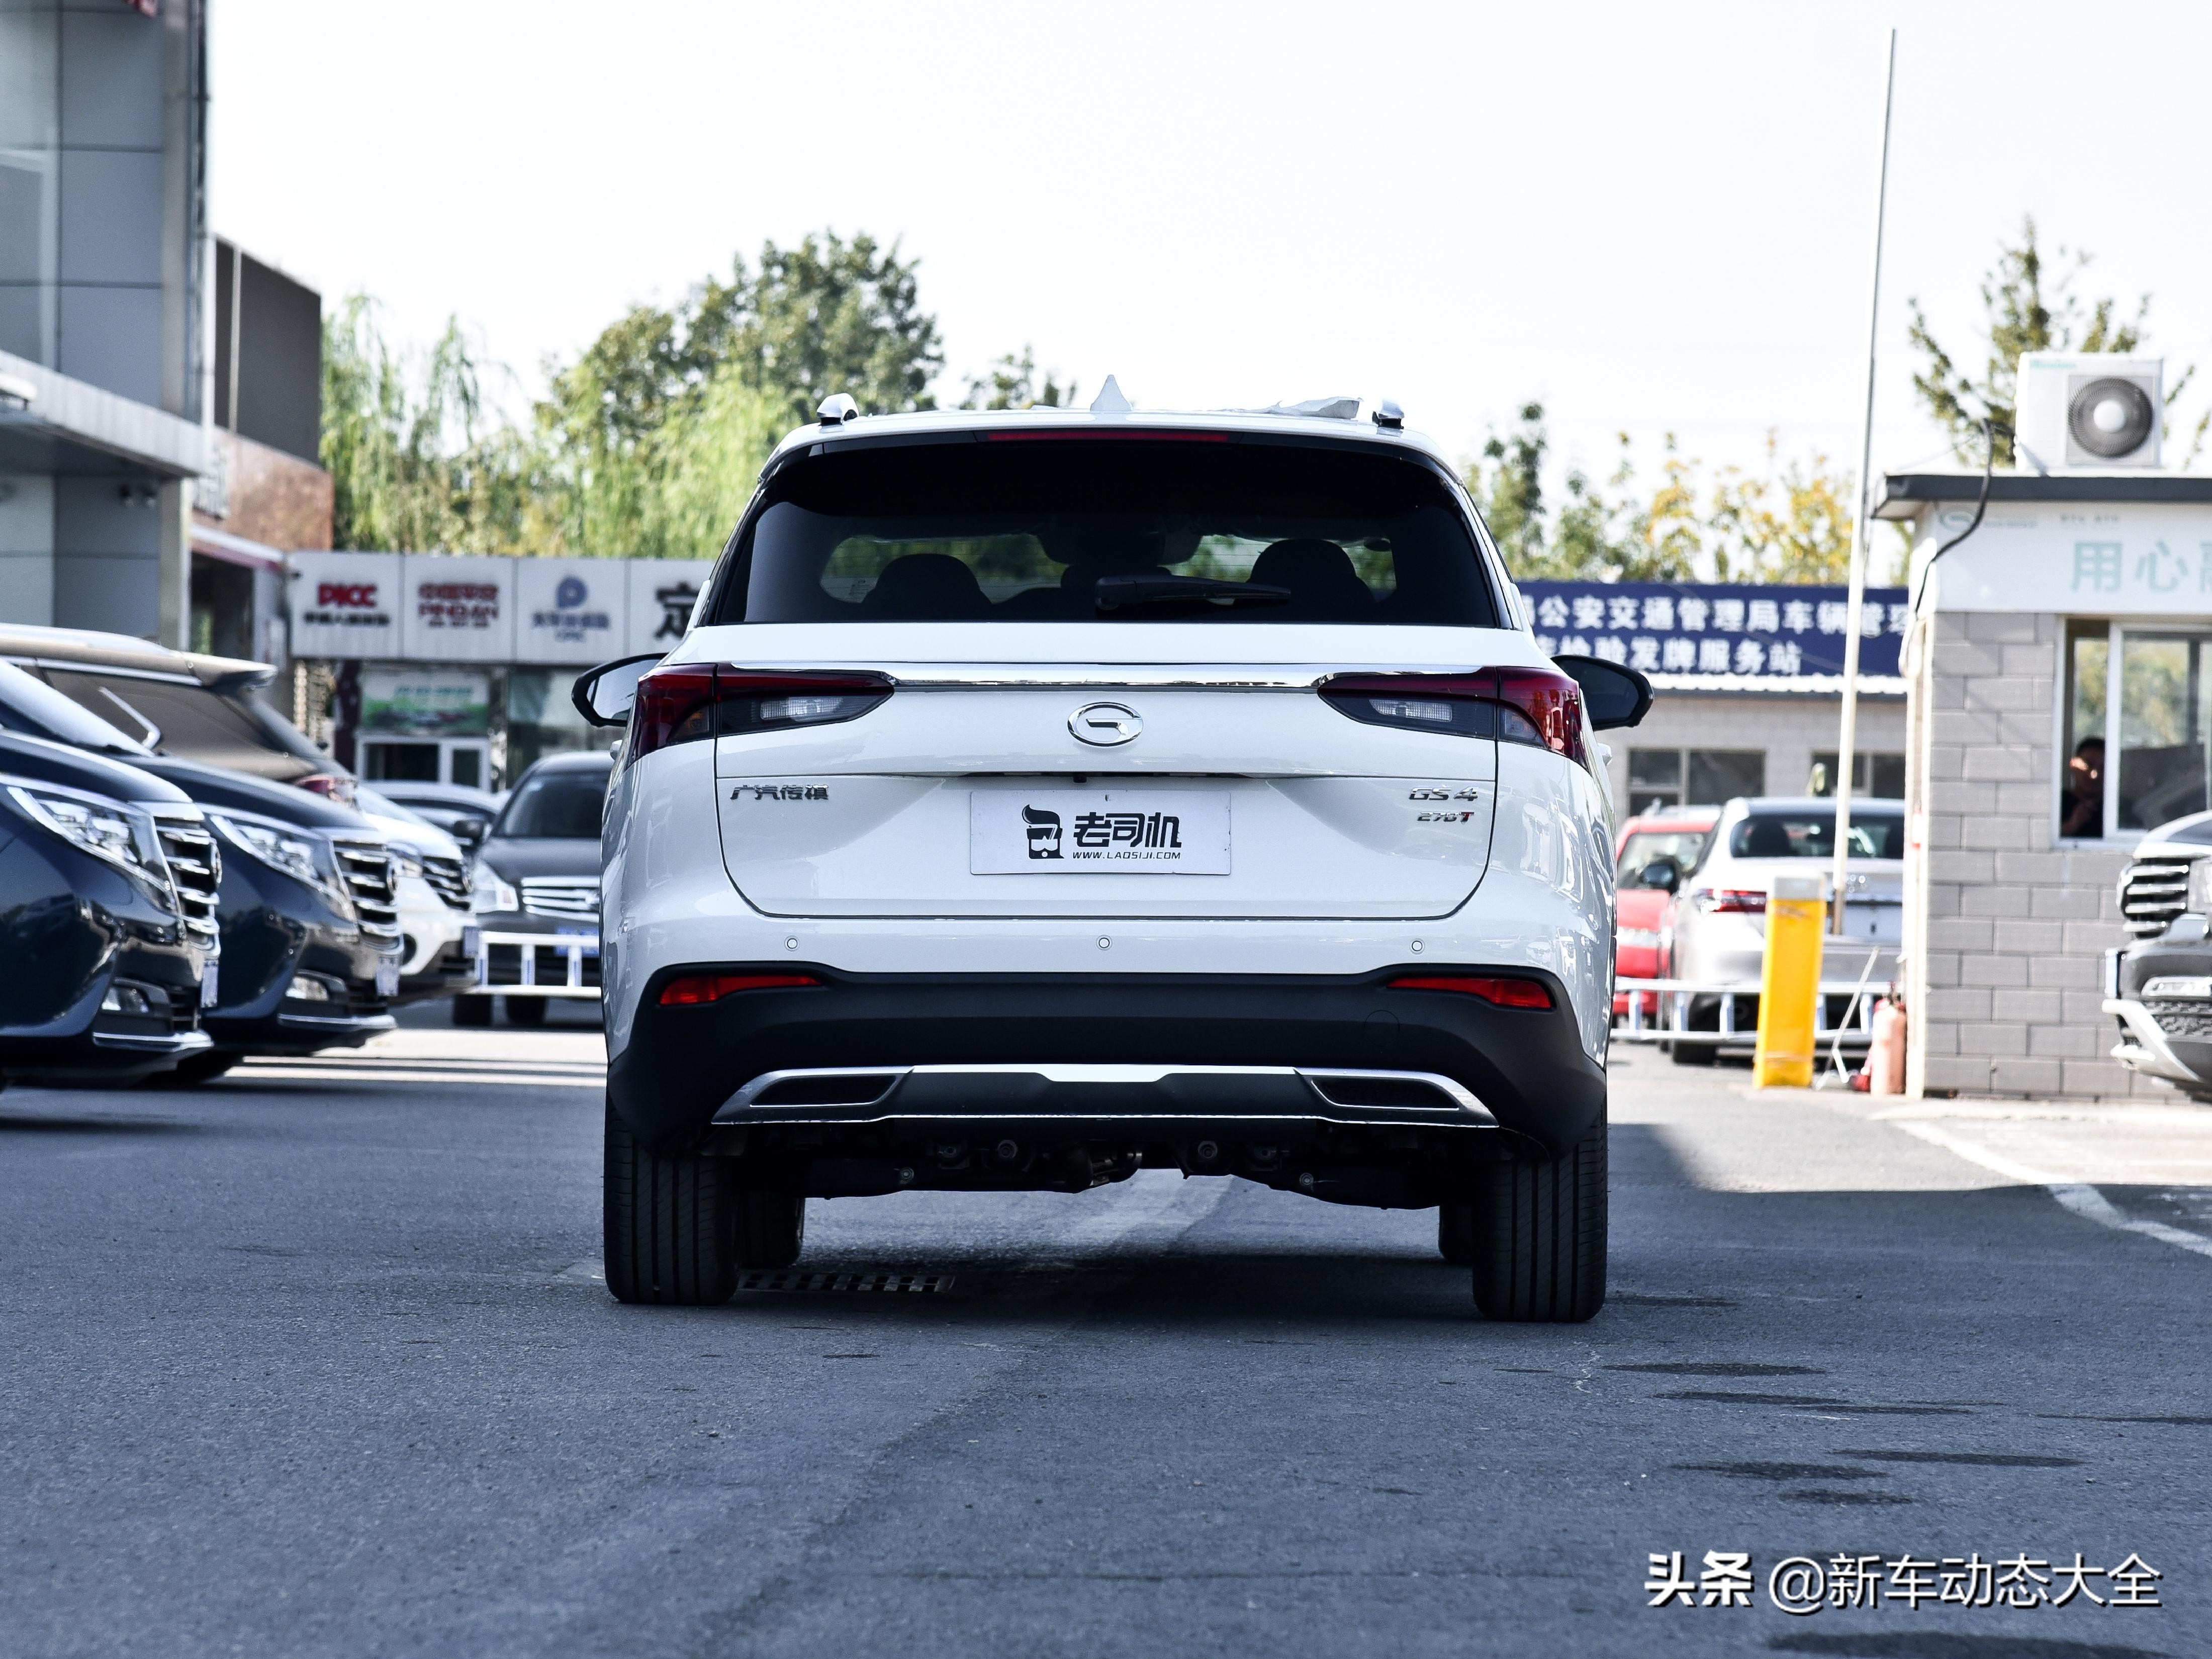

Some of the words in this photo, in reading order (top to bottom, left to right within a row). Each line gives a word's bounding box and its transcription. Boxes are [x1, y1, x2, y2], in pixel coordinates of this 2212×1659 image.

[730, 784, 829, 800] 广汽传祺
[1417, 811, 1474, 823] 270T
[1073, 812, 1182, 848] 老司机
[1072, 851, 1181, 859] WWW.LAOSIJI.COM
